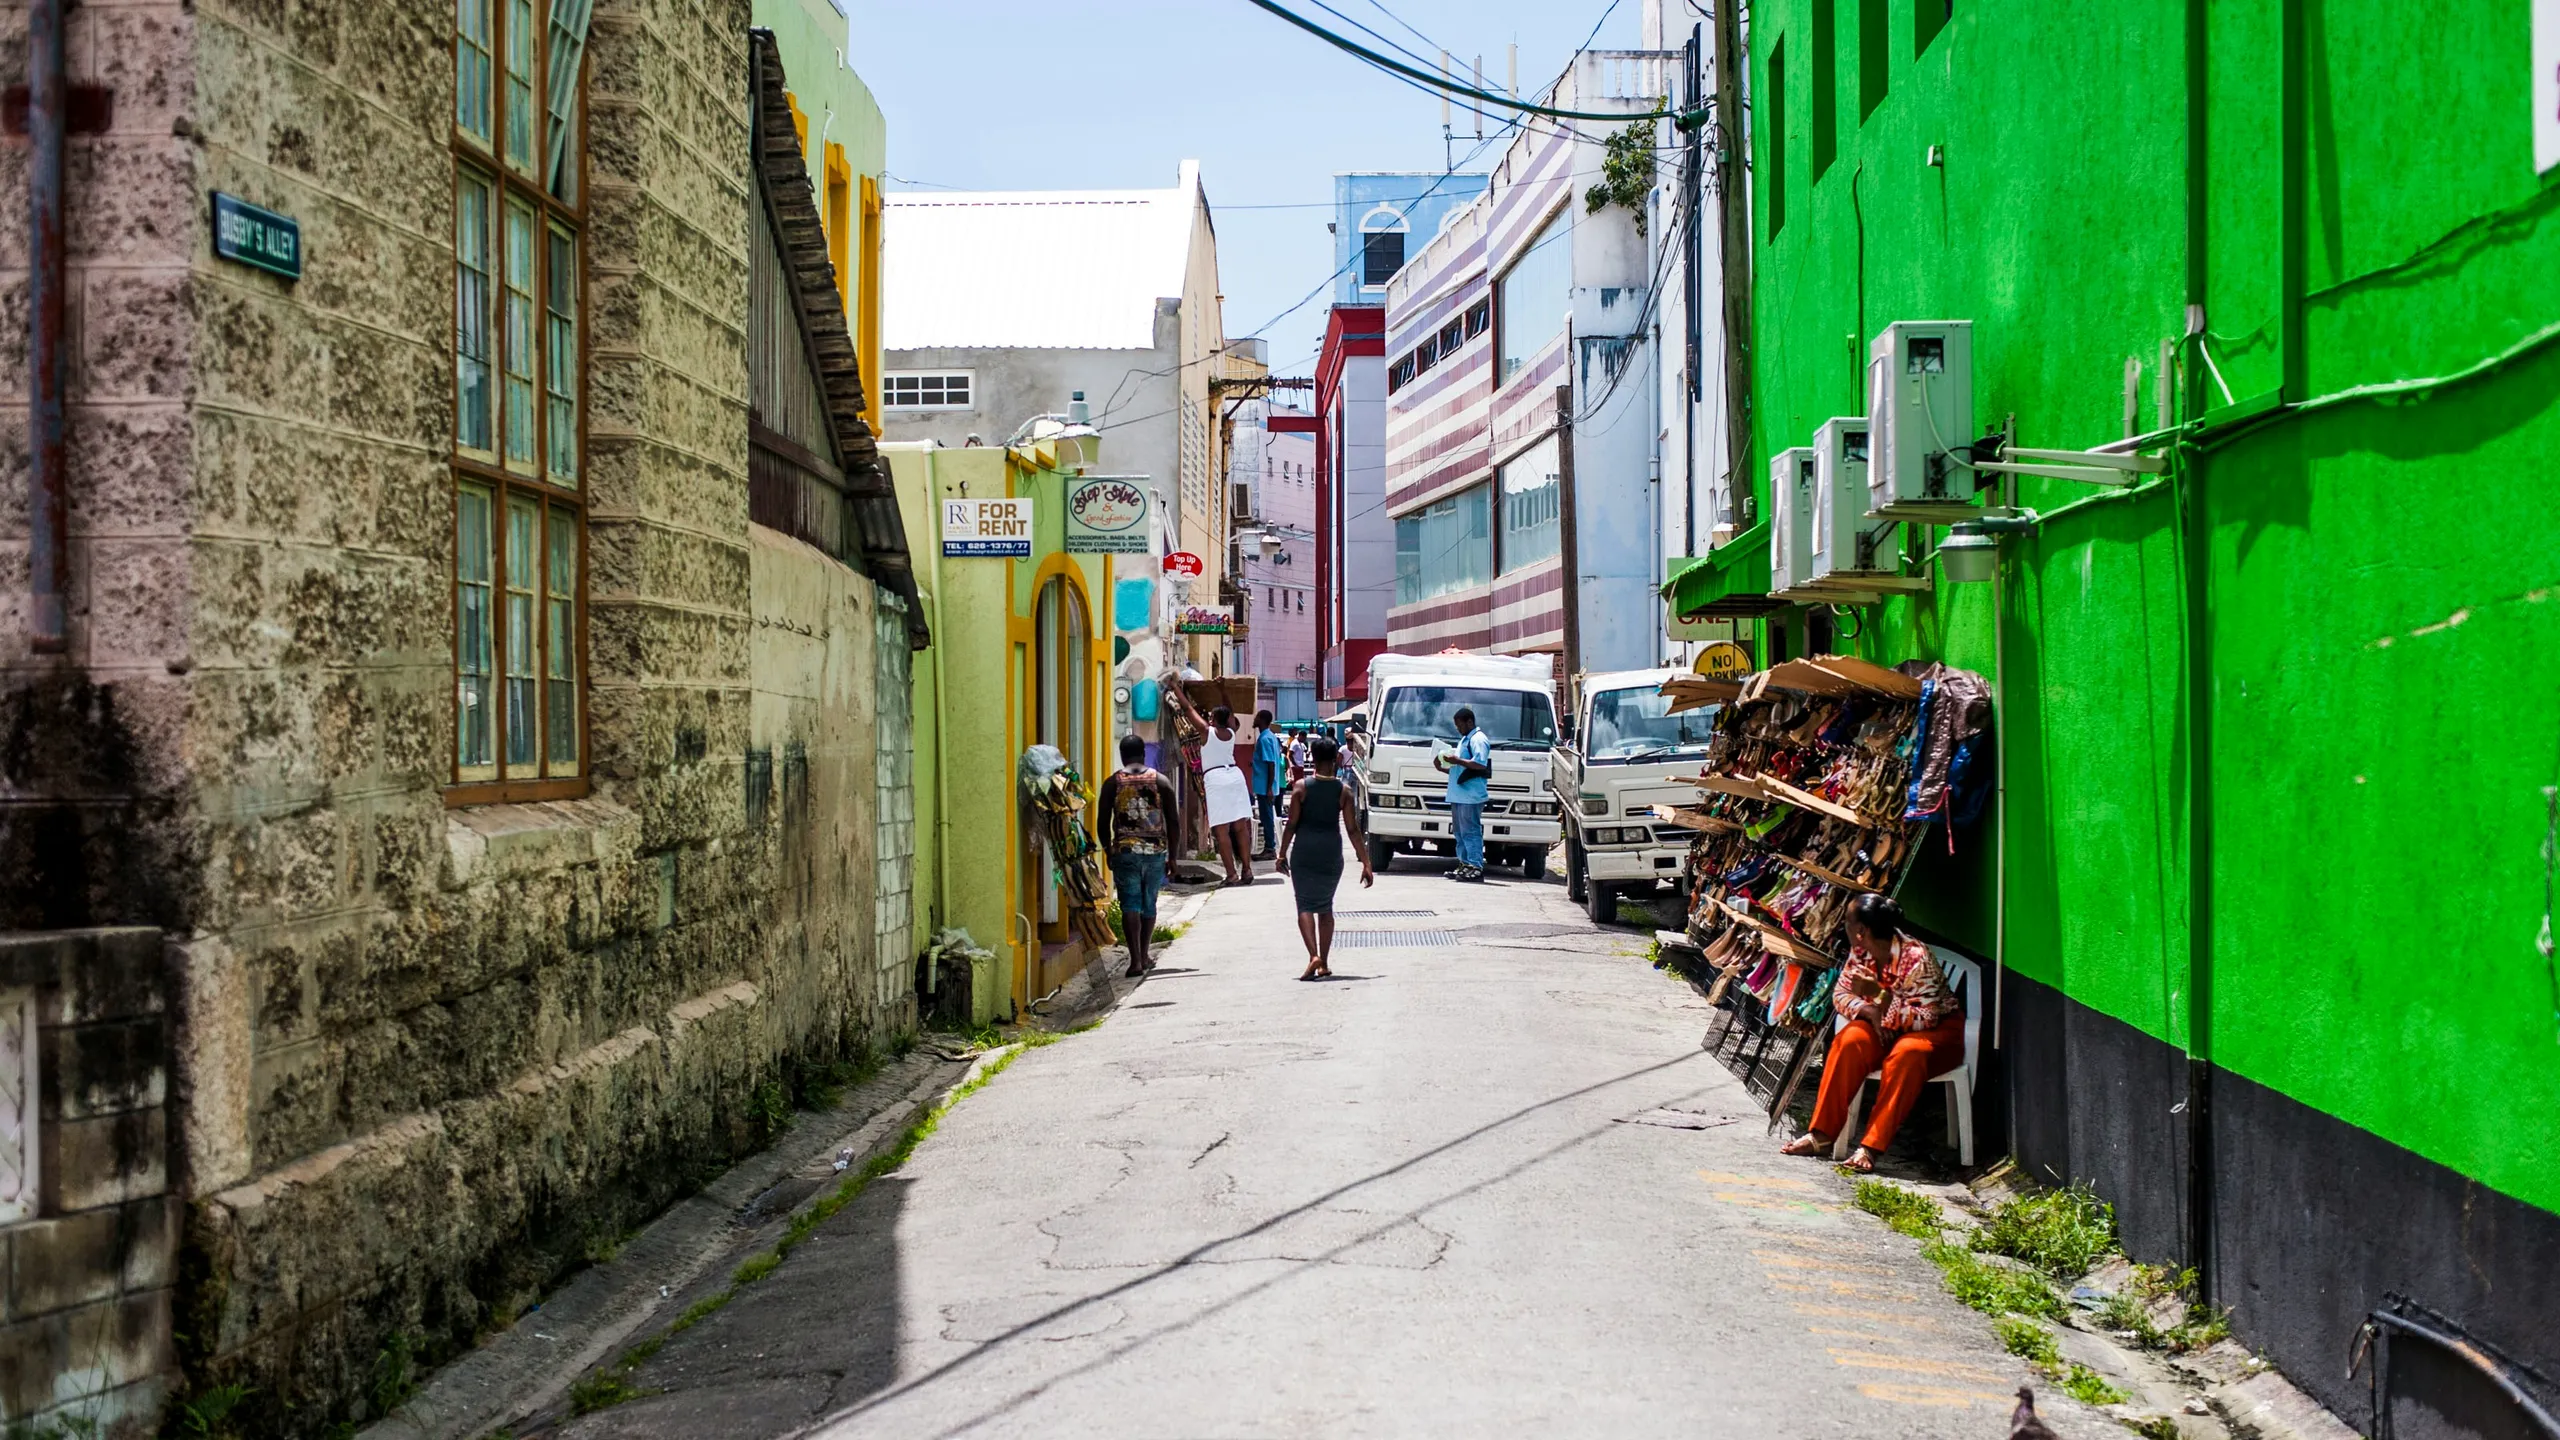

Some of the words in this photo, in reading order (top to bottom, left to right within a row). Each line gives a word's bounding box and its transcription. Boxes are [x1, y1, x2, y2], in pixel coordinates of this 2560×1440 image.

[220, 208, 264, 252] BUSBY'S
[266, 225, 294, 261] ALLEY
[1074, 485, 1100, 514] Step
[1104, 483, 1140, 507] Style
[978, 503, 1017, 518] FOR
[978, 520, 1028, 536] RENT
[1173, 554, 1185, 563] Top
[1186, 555, 1196, 564] Up
[1175, 563, 1192, 571] Here
[1712, 654, 1732, 669] NO
